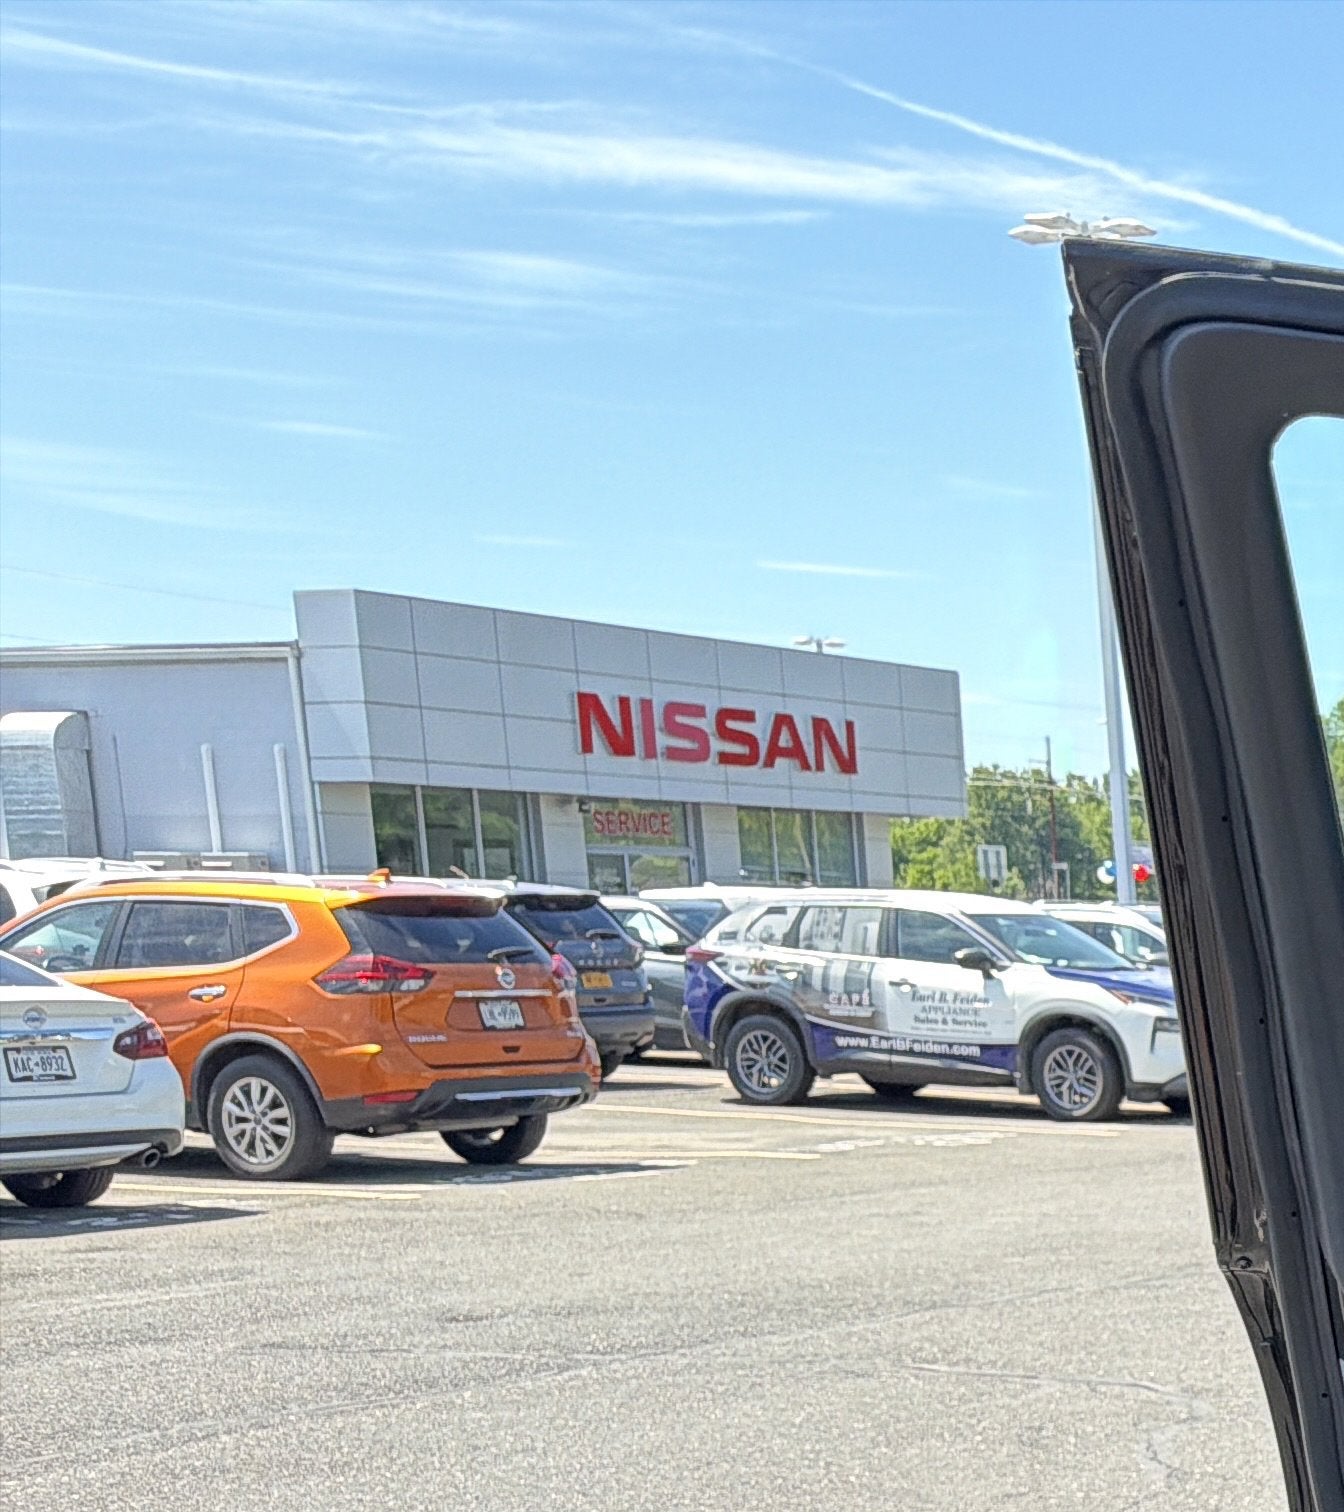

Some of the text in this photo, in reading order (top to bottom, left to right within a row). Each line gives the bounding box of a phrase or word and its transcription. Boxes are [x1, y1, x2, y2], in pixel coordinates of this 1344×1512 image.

[576, 691, 858, 775] NISSAN
[592, 809, 673, 837] SERVICE
[941, 1016, 949, 1026] &
[952, 1017, 988, 1028] Service
